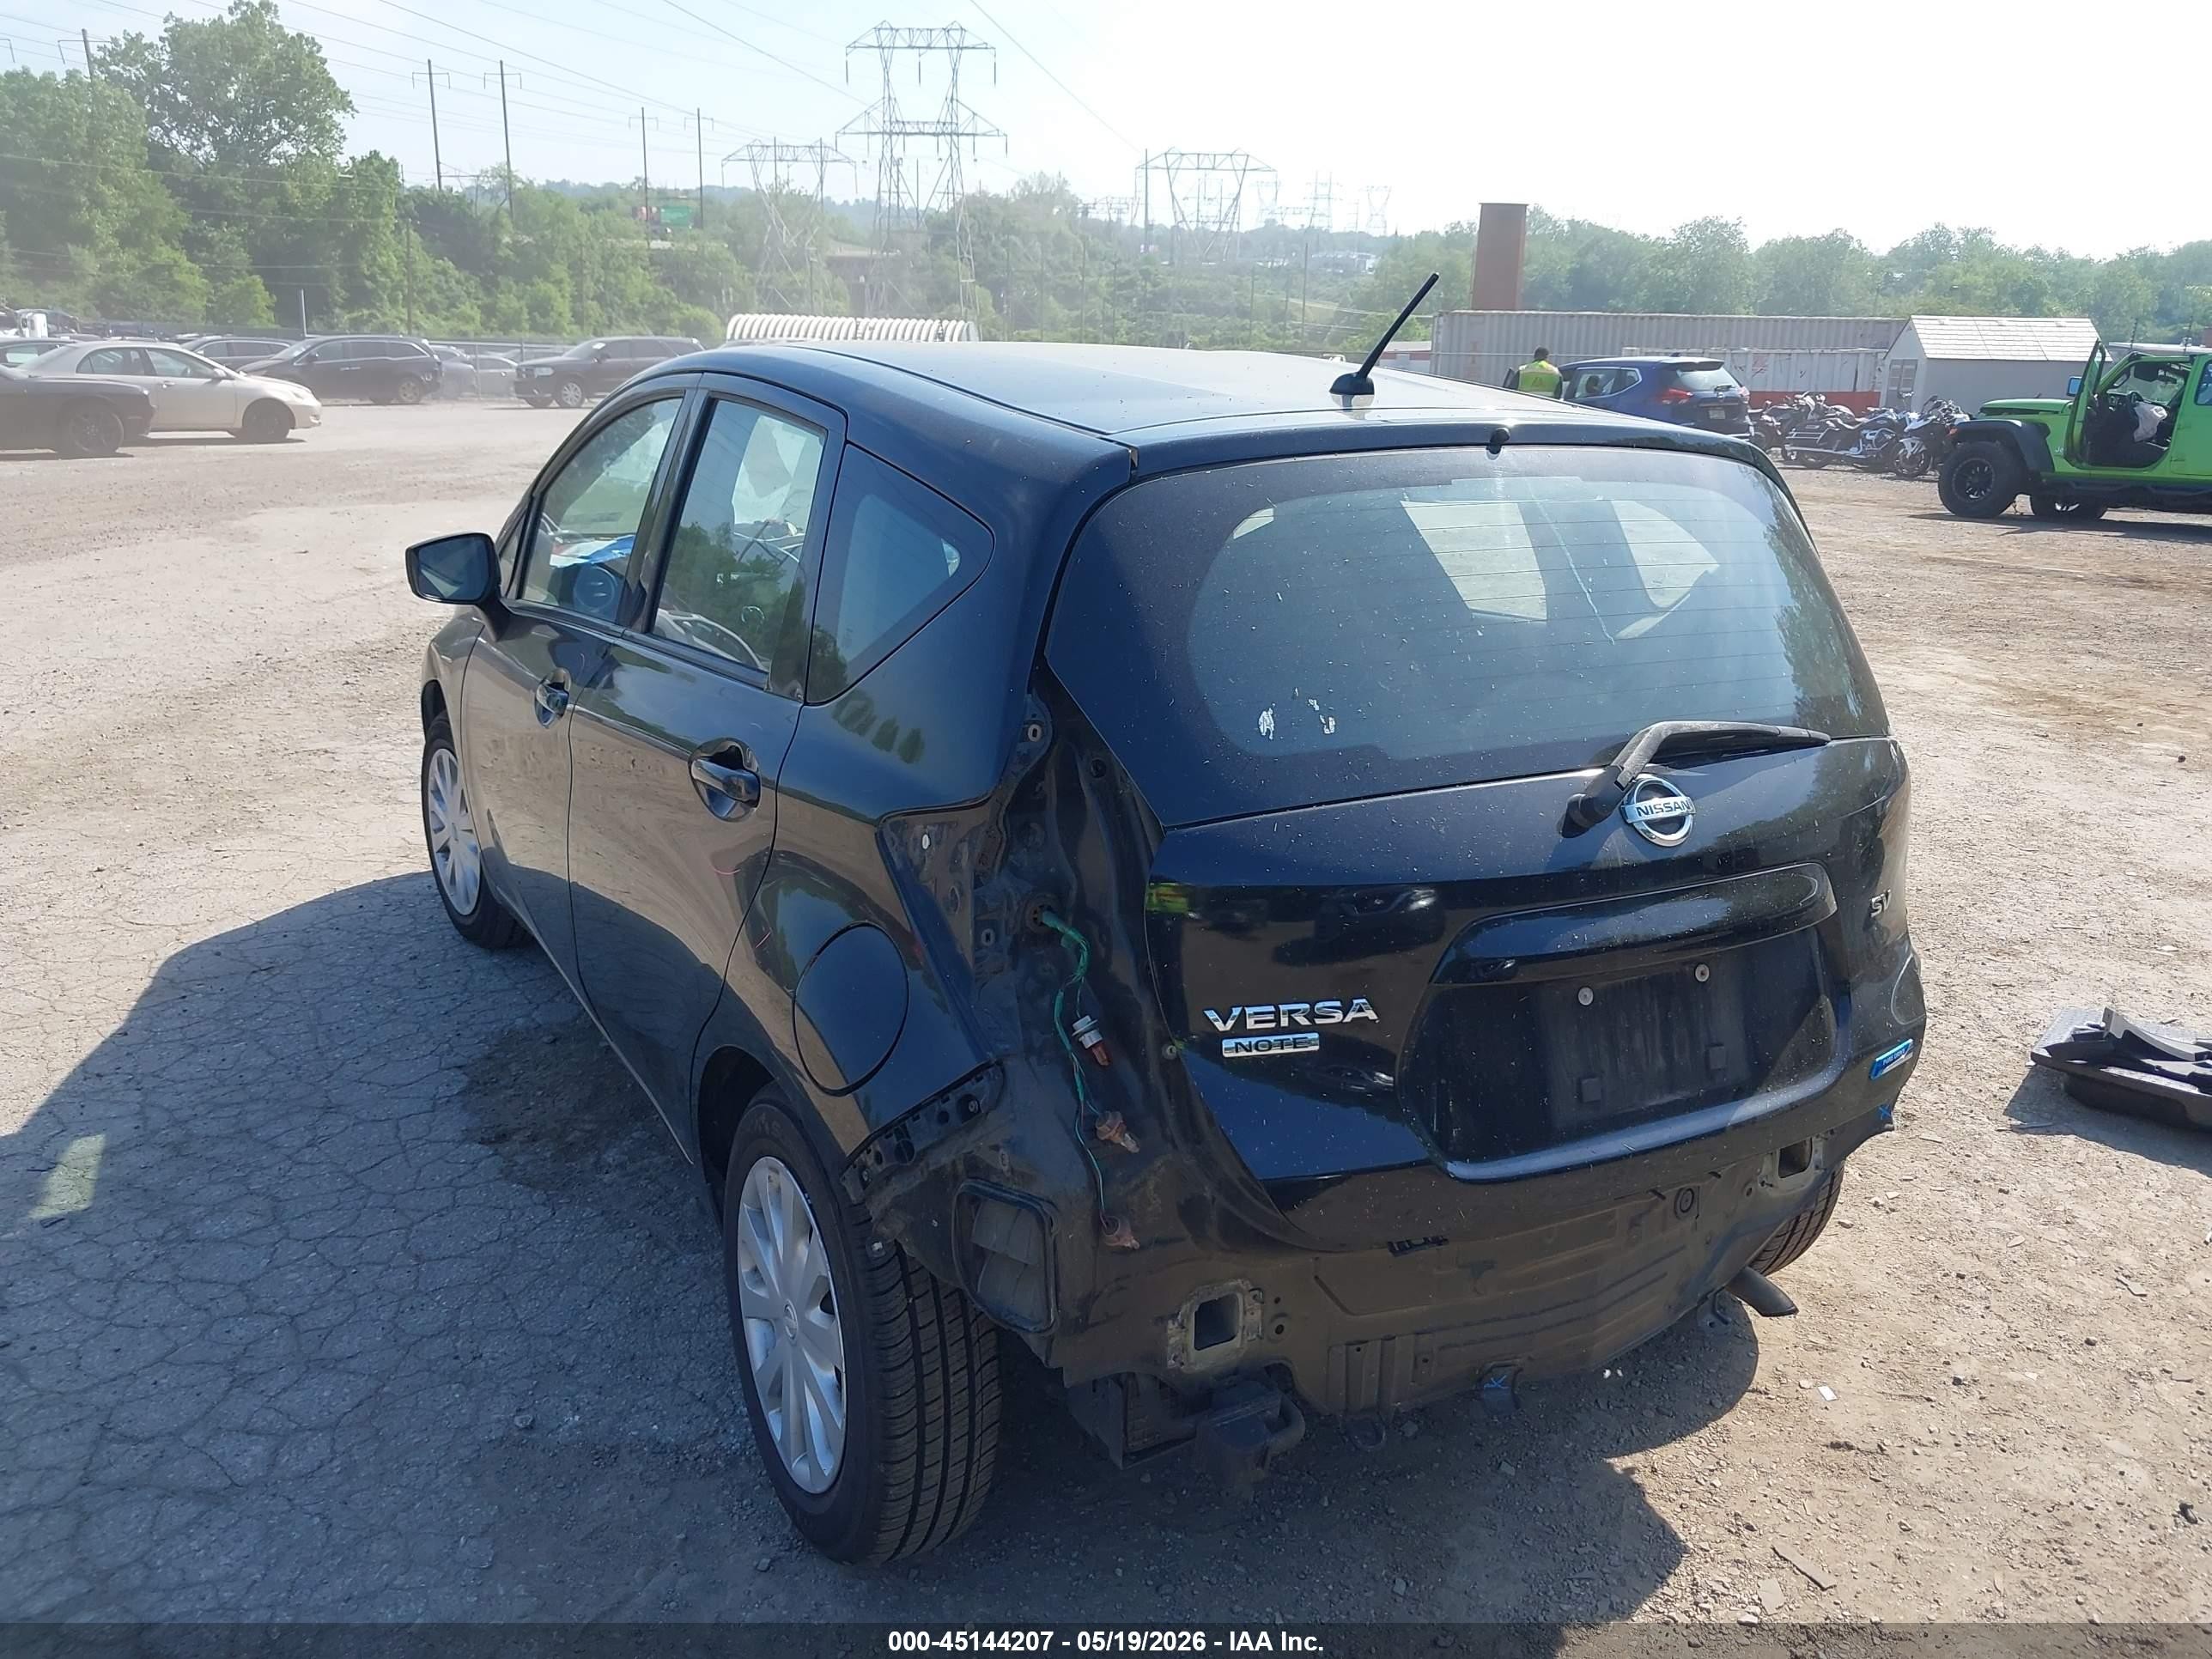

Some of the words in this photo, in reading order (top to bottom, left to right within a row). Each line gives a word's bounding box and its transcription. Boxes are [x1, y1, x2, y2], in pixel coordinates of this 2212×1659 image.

[1636, 799, 1692, 817] NISSAN
[1870, 889, 1892, 918] SV
[1203, 998, 1378, 1032] VERSA
[1234, 1036, 1309, 1054] NOTE
